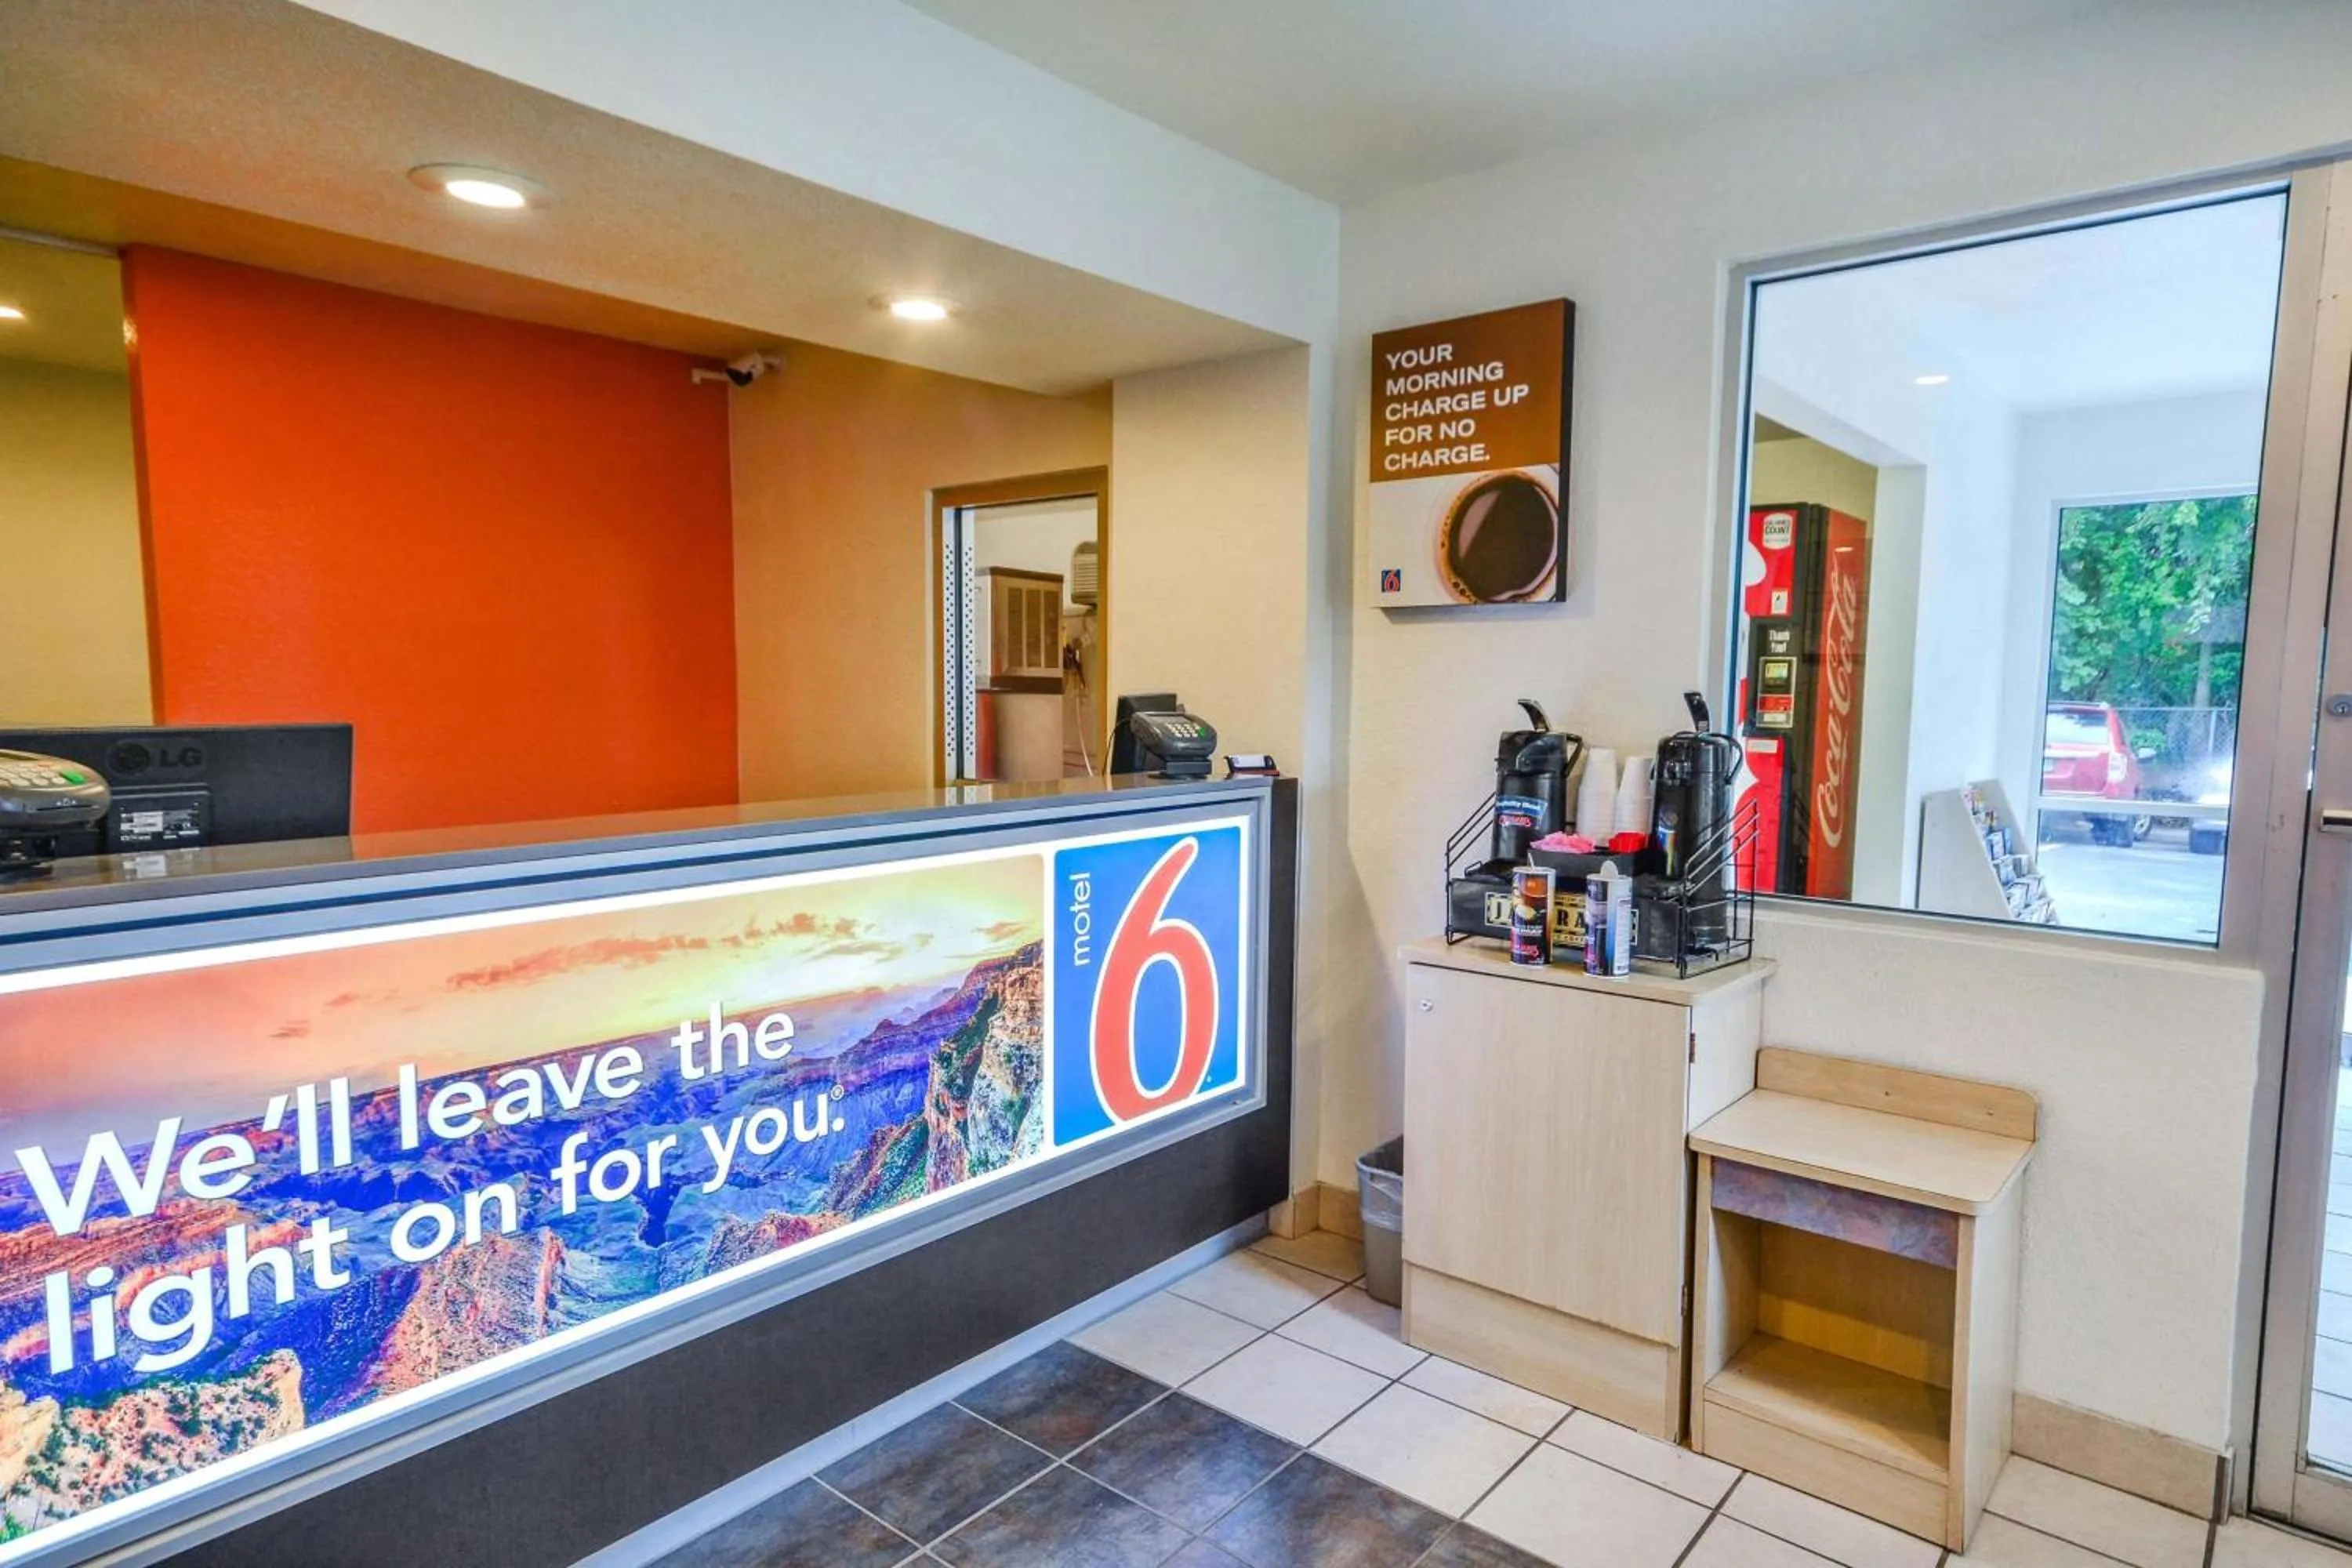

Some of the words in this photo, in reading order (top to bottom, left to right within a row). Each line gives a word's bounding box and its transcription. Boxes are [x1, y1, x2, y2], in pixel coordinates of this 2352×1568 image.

[1386, 343, 1453, 371] YOUR
[1386, 361, 1504, 396] MORNING
[1385, 391, 1486, 421] CHARGE
[1494, 384, 1529, 406] UP
[1385, 424, 1432, 446] FOR
[1439, 419, 1475, 437] NO
[1385, 443, 1490, 471] CHARGE.
[1817, 555, 1857, 848] Coca-Cola
[160, 747, 202, 768] LG
[1069, 872, 1091, 967] motel
[1090, 837, 1219, 1125] 6
[14, 1079, 351, 1236] We'll
[399, 1045, 643, 1151] leave
[670, 1001, 795, 1080] the
[45, 1226, 350, 1374] light
[390, 1181, 516, 1263] on
[552, 1136, 684, 1215] for
